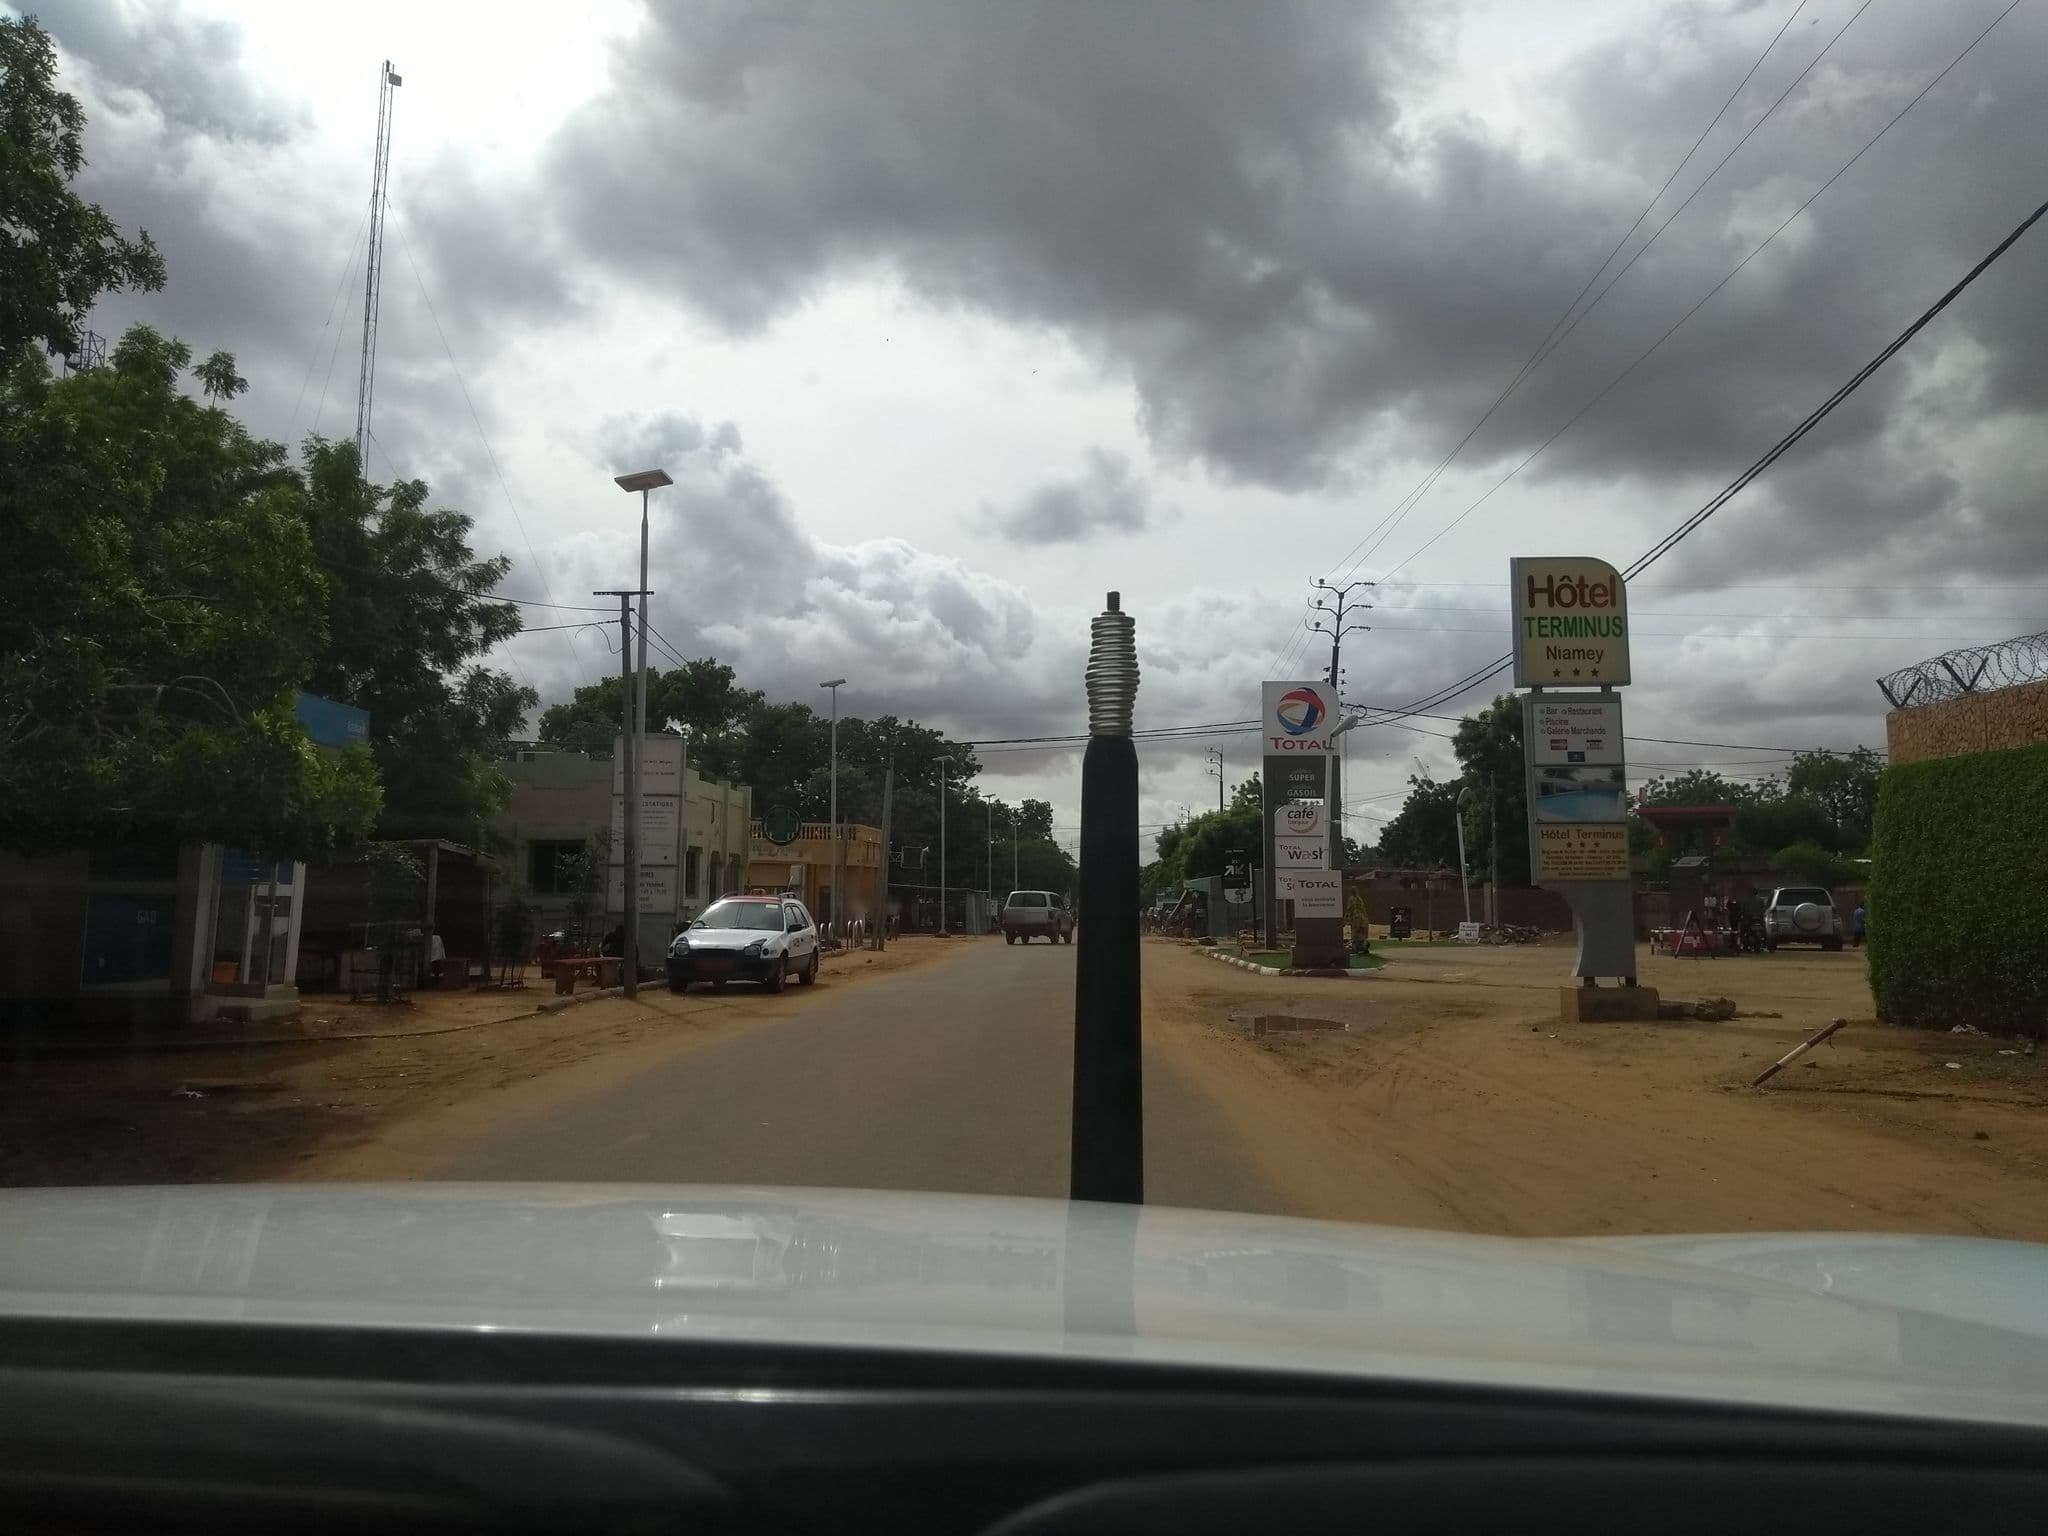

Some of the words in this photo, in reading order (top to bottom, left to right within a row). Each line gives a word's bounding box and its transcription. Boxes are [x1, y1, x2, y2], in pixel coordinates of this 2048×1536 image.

[1527, 574, 1616, 608] Hôtel
[1524, 615, 1623, 638] TERMINUS
[1546, 645, 1604, 664] Niamey
[1546, 707, 1558, 715] Bar
[1568, 707, 1602, 715] Restaurant
[1545, 717, 1569, 725] Piscine
[1546, 726, 1569, 735] Galerie
[1270, 736, 1336, 751] TOTAL
[1288, 774, 1315, 782] SUPER
[1287, 789, 1317, 797] GASOIL
[1287, 807, 1314, 819] café
[1576, 828, 1624, 840] Terminus
[1297, 879, 1338, 889] TOTAL
